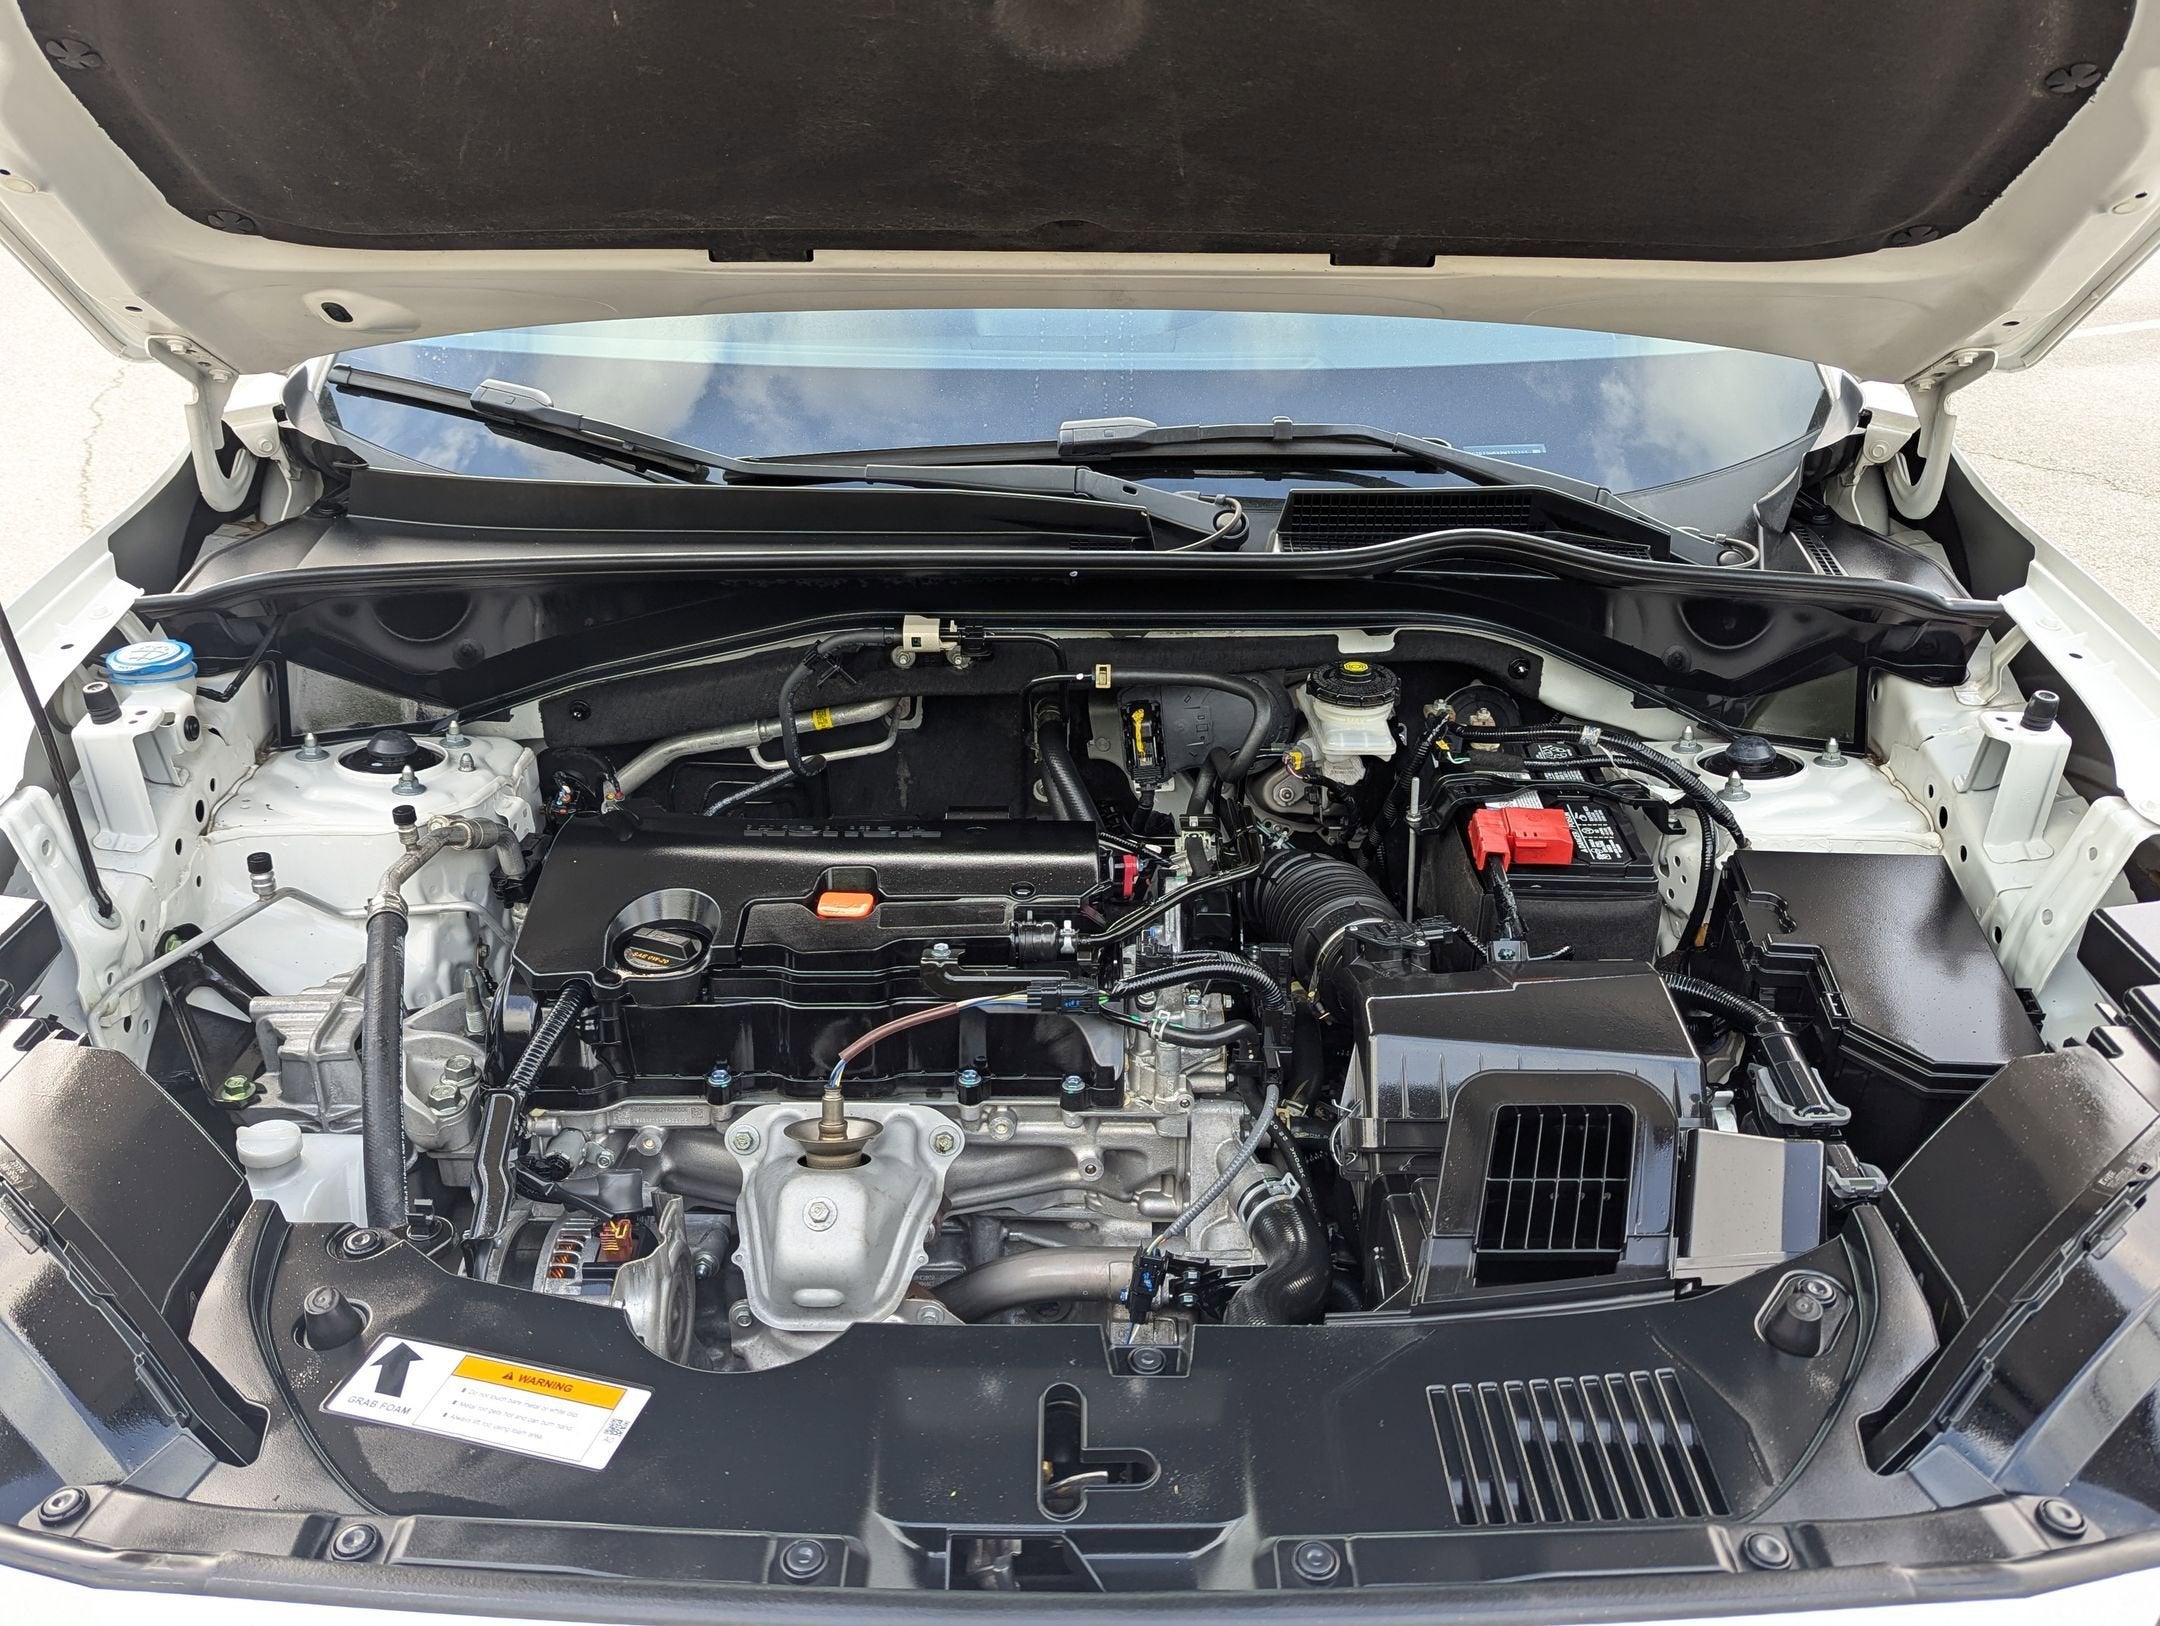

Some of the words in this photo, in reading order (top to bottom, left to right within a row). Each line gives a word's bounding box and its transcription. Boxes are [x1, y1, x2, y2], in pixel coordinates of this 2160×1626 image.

[632, 951, 648, 959] SAE
[648, 956, 670, 965] 0W-20
[519, 1374, 573, 1393] WARNING
[347, 1396, 378, 1408] GRAB
[380, 1402, 411, 1415] FOAM
